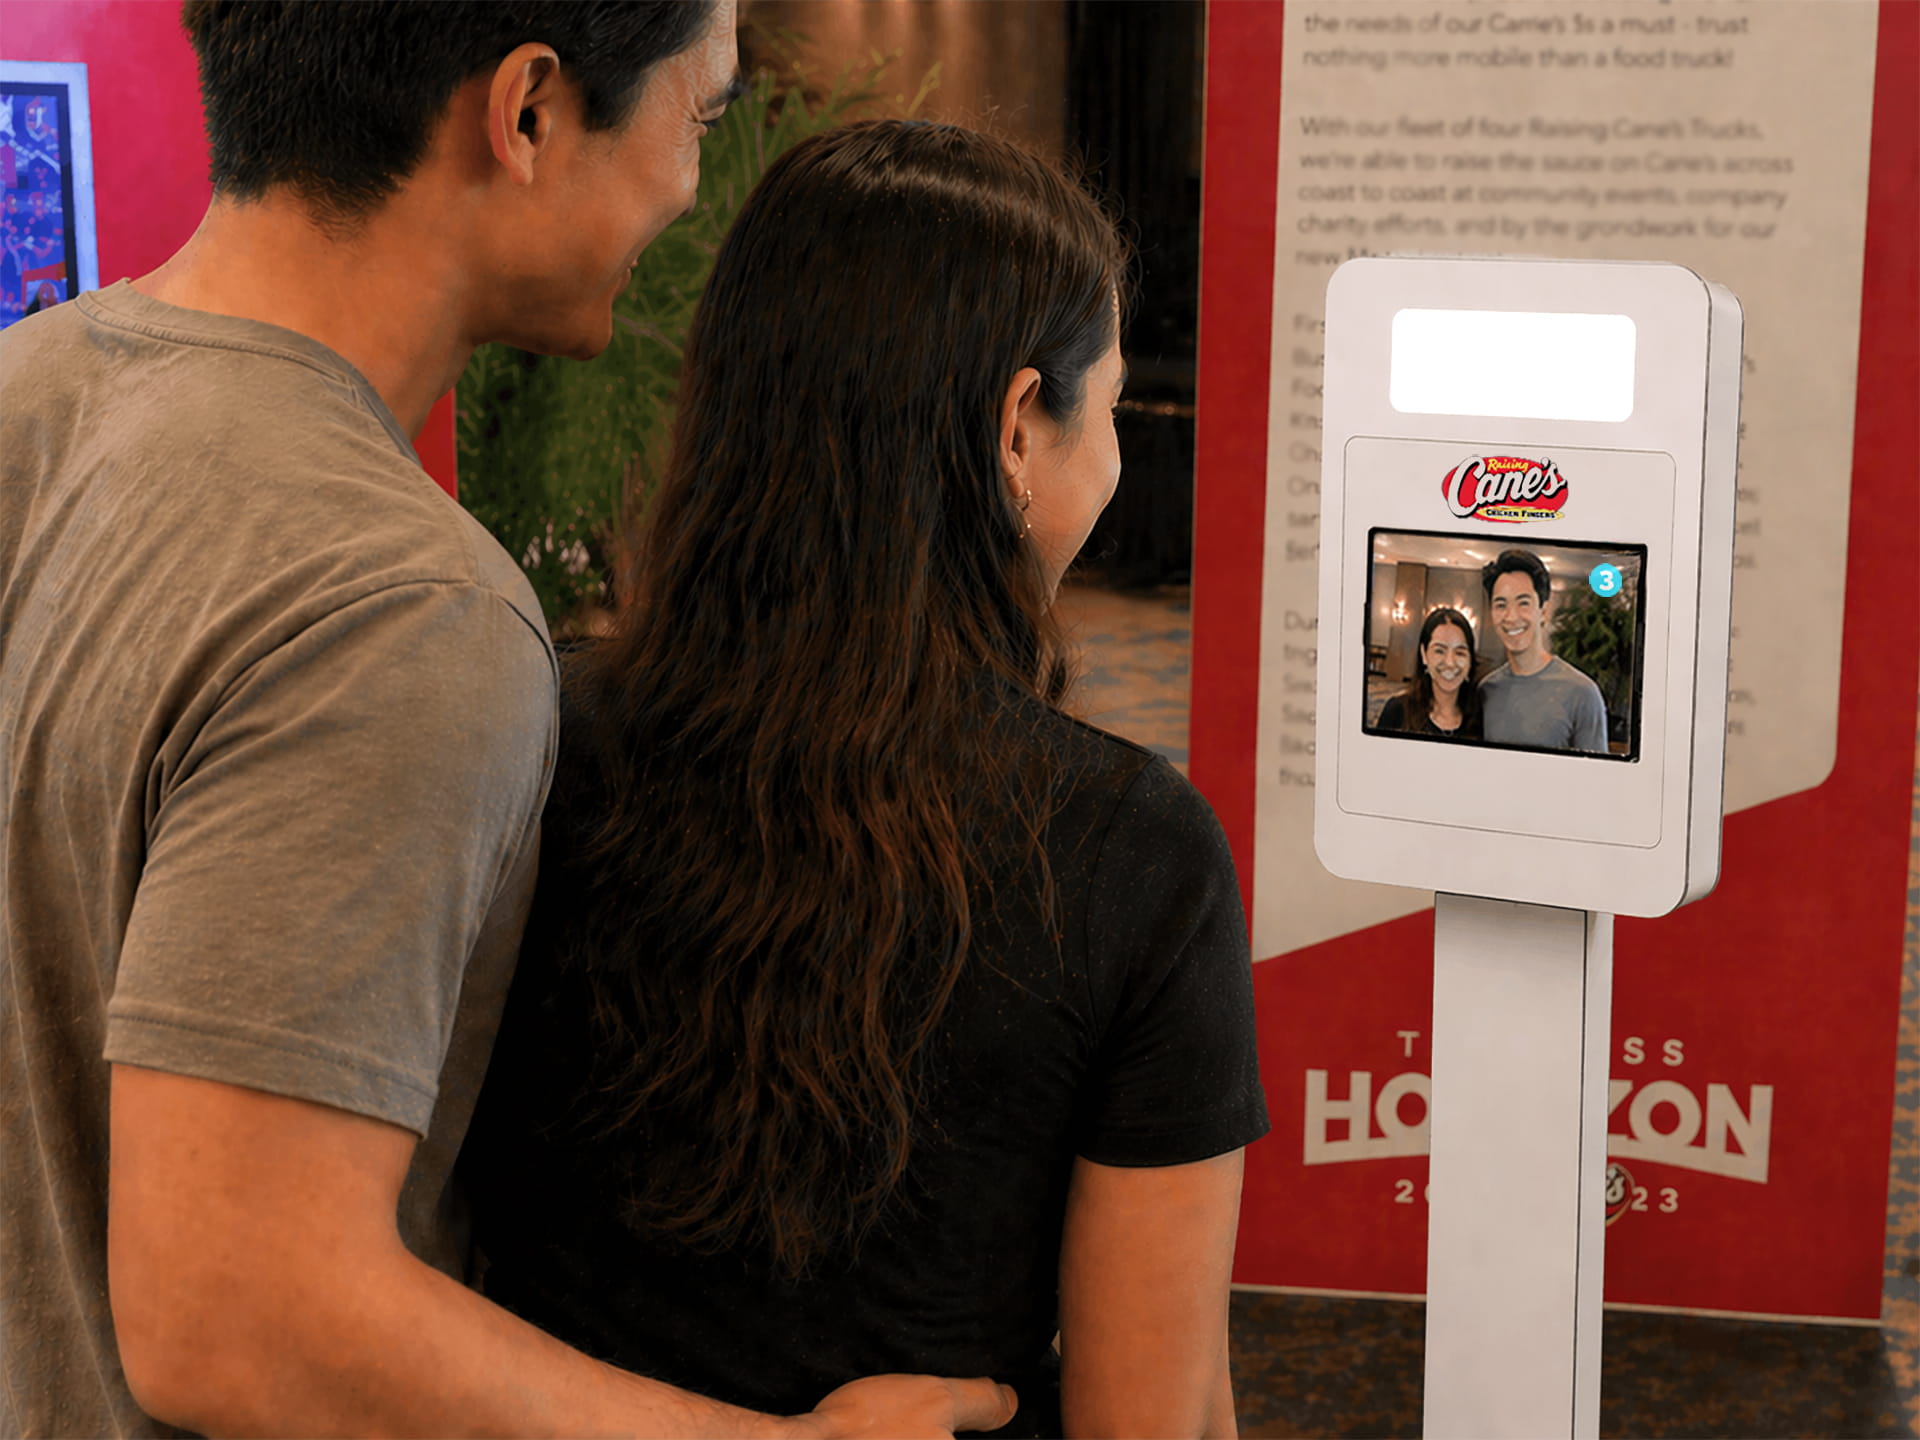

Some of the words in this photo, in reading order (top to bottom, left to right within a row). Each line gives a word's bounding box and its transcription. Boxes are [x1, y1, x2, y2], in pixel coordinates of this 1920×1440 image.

[1304, 13, 1340, 34] the
[1418, 11, 1442, 34] of
[1446, 17, 1482, 34] our
[1619, 15, 1676, 35] must
[1696, 15, 1749, 35] trust
[1455, 46, 1533, 69] mobile
[1539, 46, 1589, 69] than
[1612, 46, 1666, 69] food
[1300, 115, 1350, 138] With
[1451, 114, 1474, 139] of
[1529, 115, 1608, 145] Raising
[1723, 156, 1795, 175] across
[1297, 183, 1354, 203] coast
[1360, 184, 1384, 203] to
[1486, 458, 1530, 474] Raising
[1447, 455, 1568, 519] Cane's
[1598, 570, 1615, 592] 3
